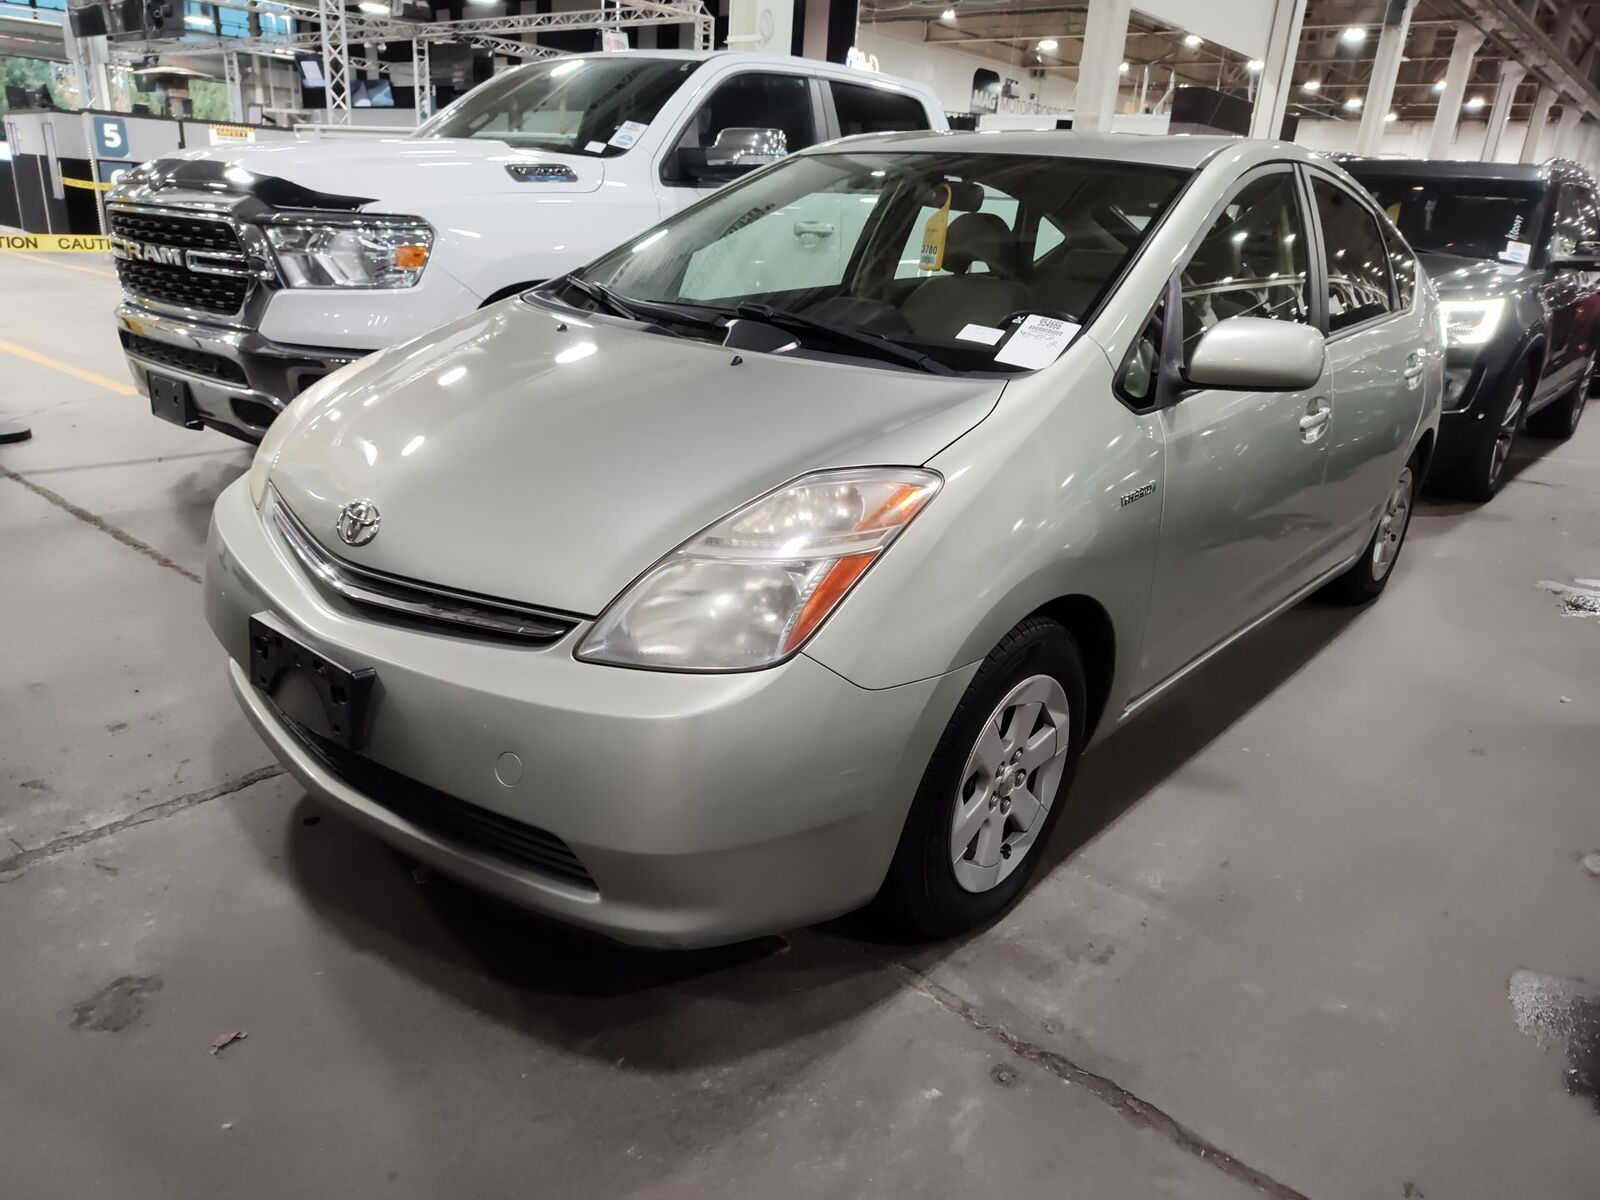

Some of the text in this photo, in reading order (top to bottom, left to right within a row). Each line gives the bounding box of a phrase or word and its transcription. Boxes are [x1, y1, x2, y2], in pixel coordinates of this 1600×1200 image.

[973, 90, 997, 110] MAG
[103, 123, 122, 148] 5
[0, 236, 113, 250] TION CAUTI
[124, 239, 182, 266] RAM
